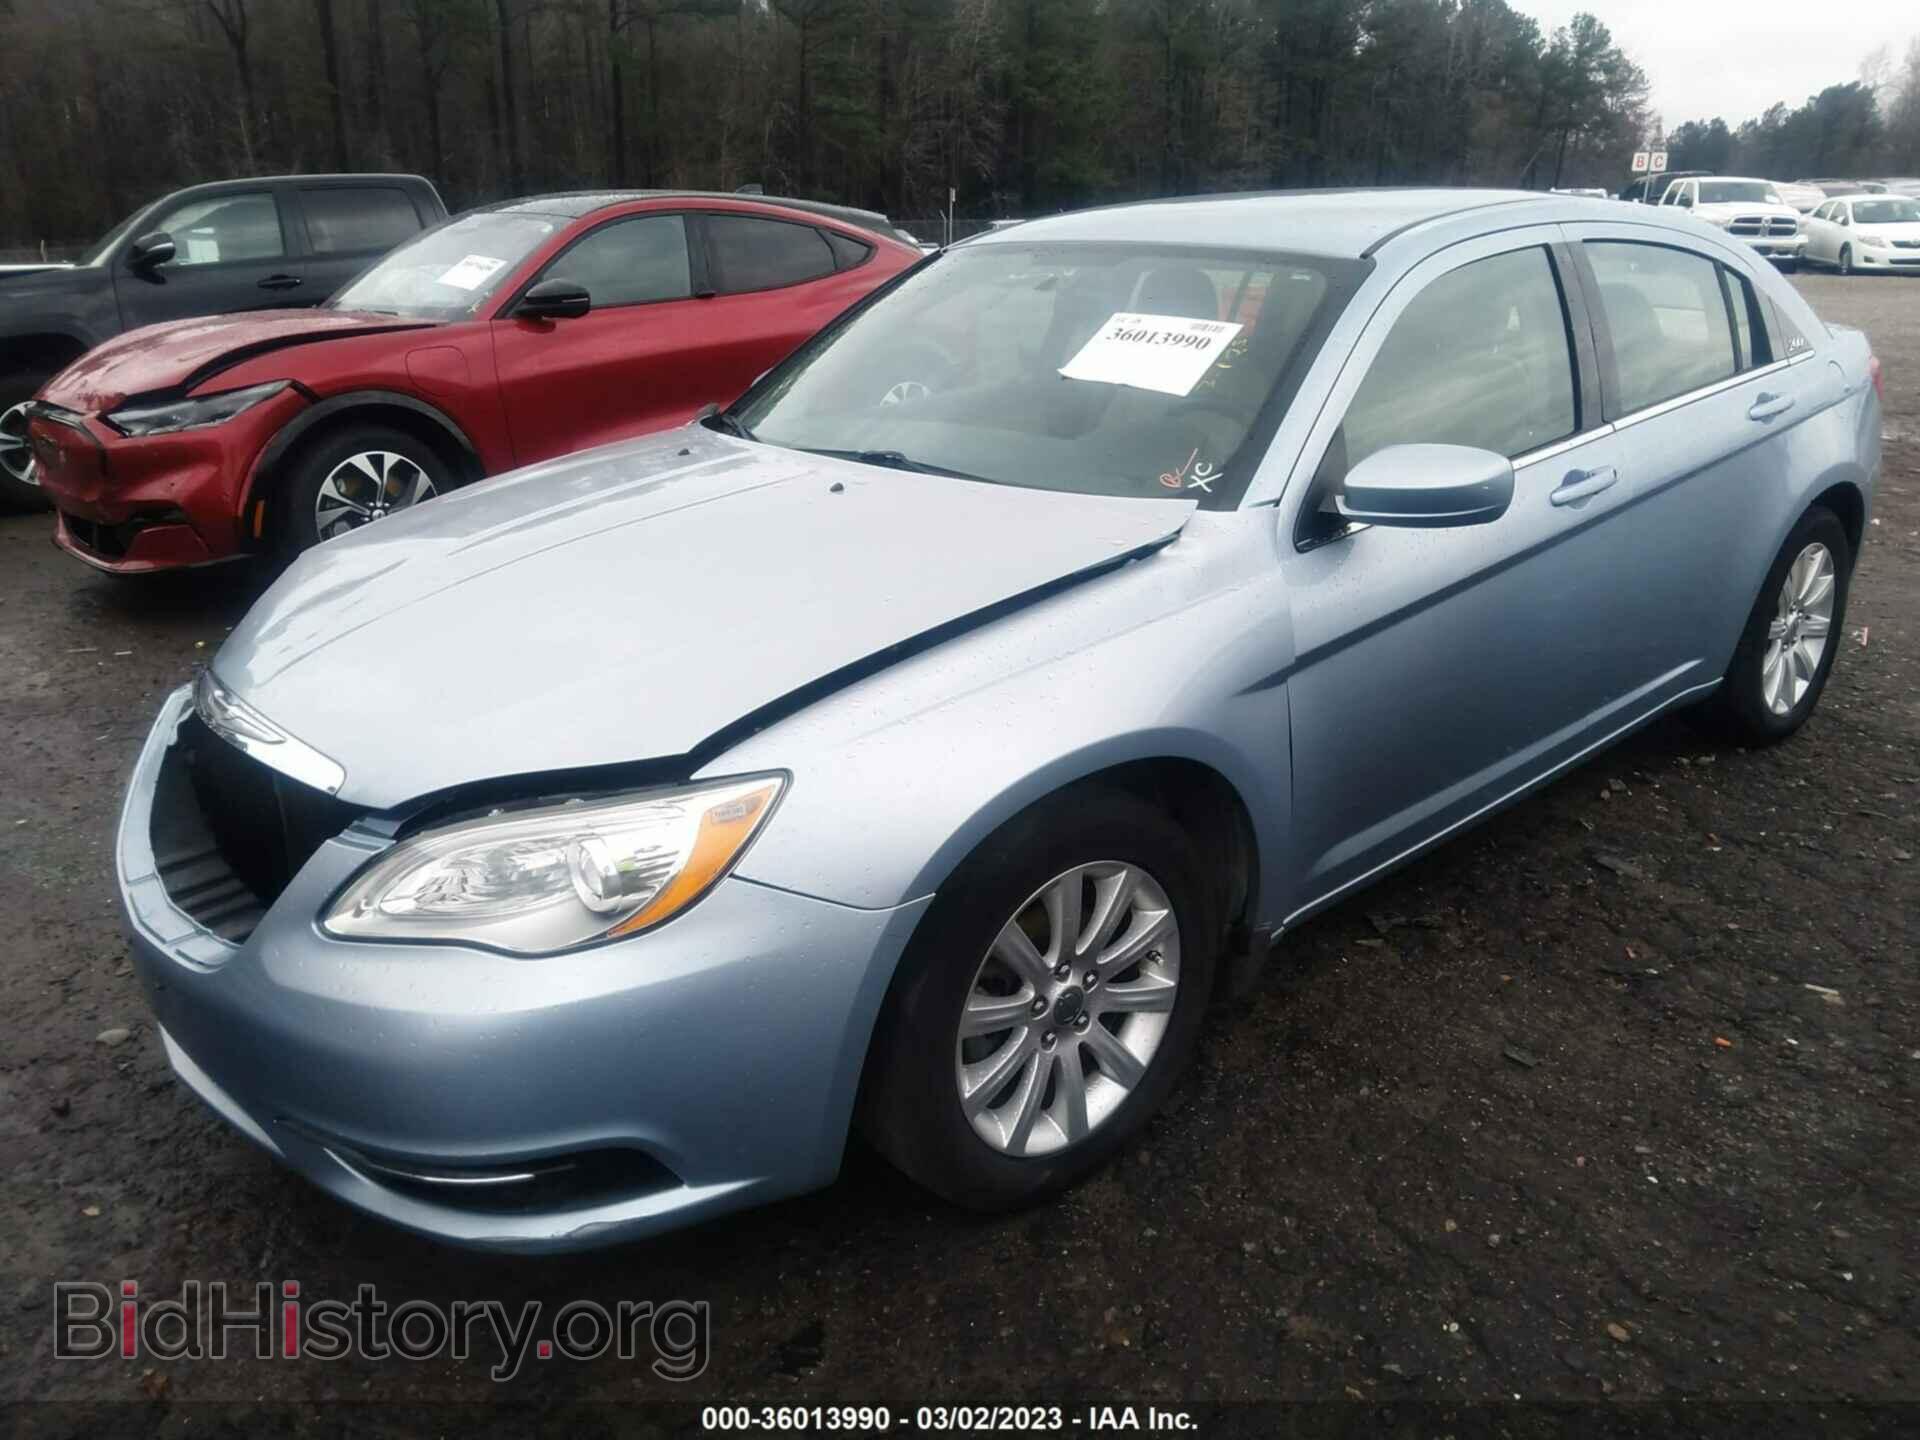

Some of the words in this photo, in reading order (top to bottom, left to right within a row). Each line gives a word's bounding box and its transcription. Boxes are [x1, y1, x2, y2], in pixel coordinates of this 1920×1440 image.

[1636, 155, 1645, 168] B
[1655, 155, 1664, 168] C
[1106, 327, 1212, 350] 36013990
